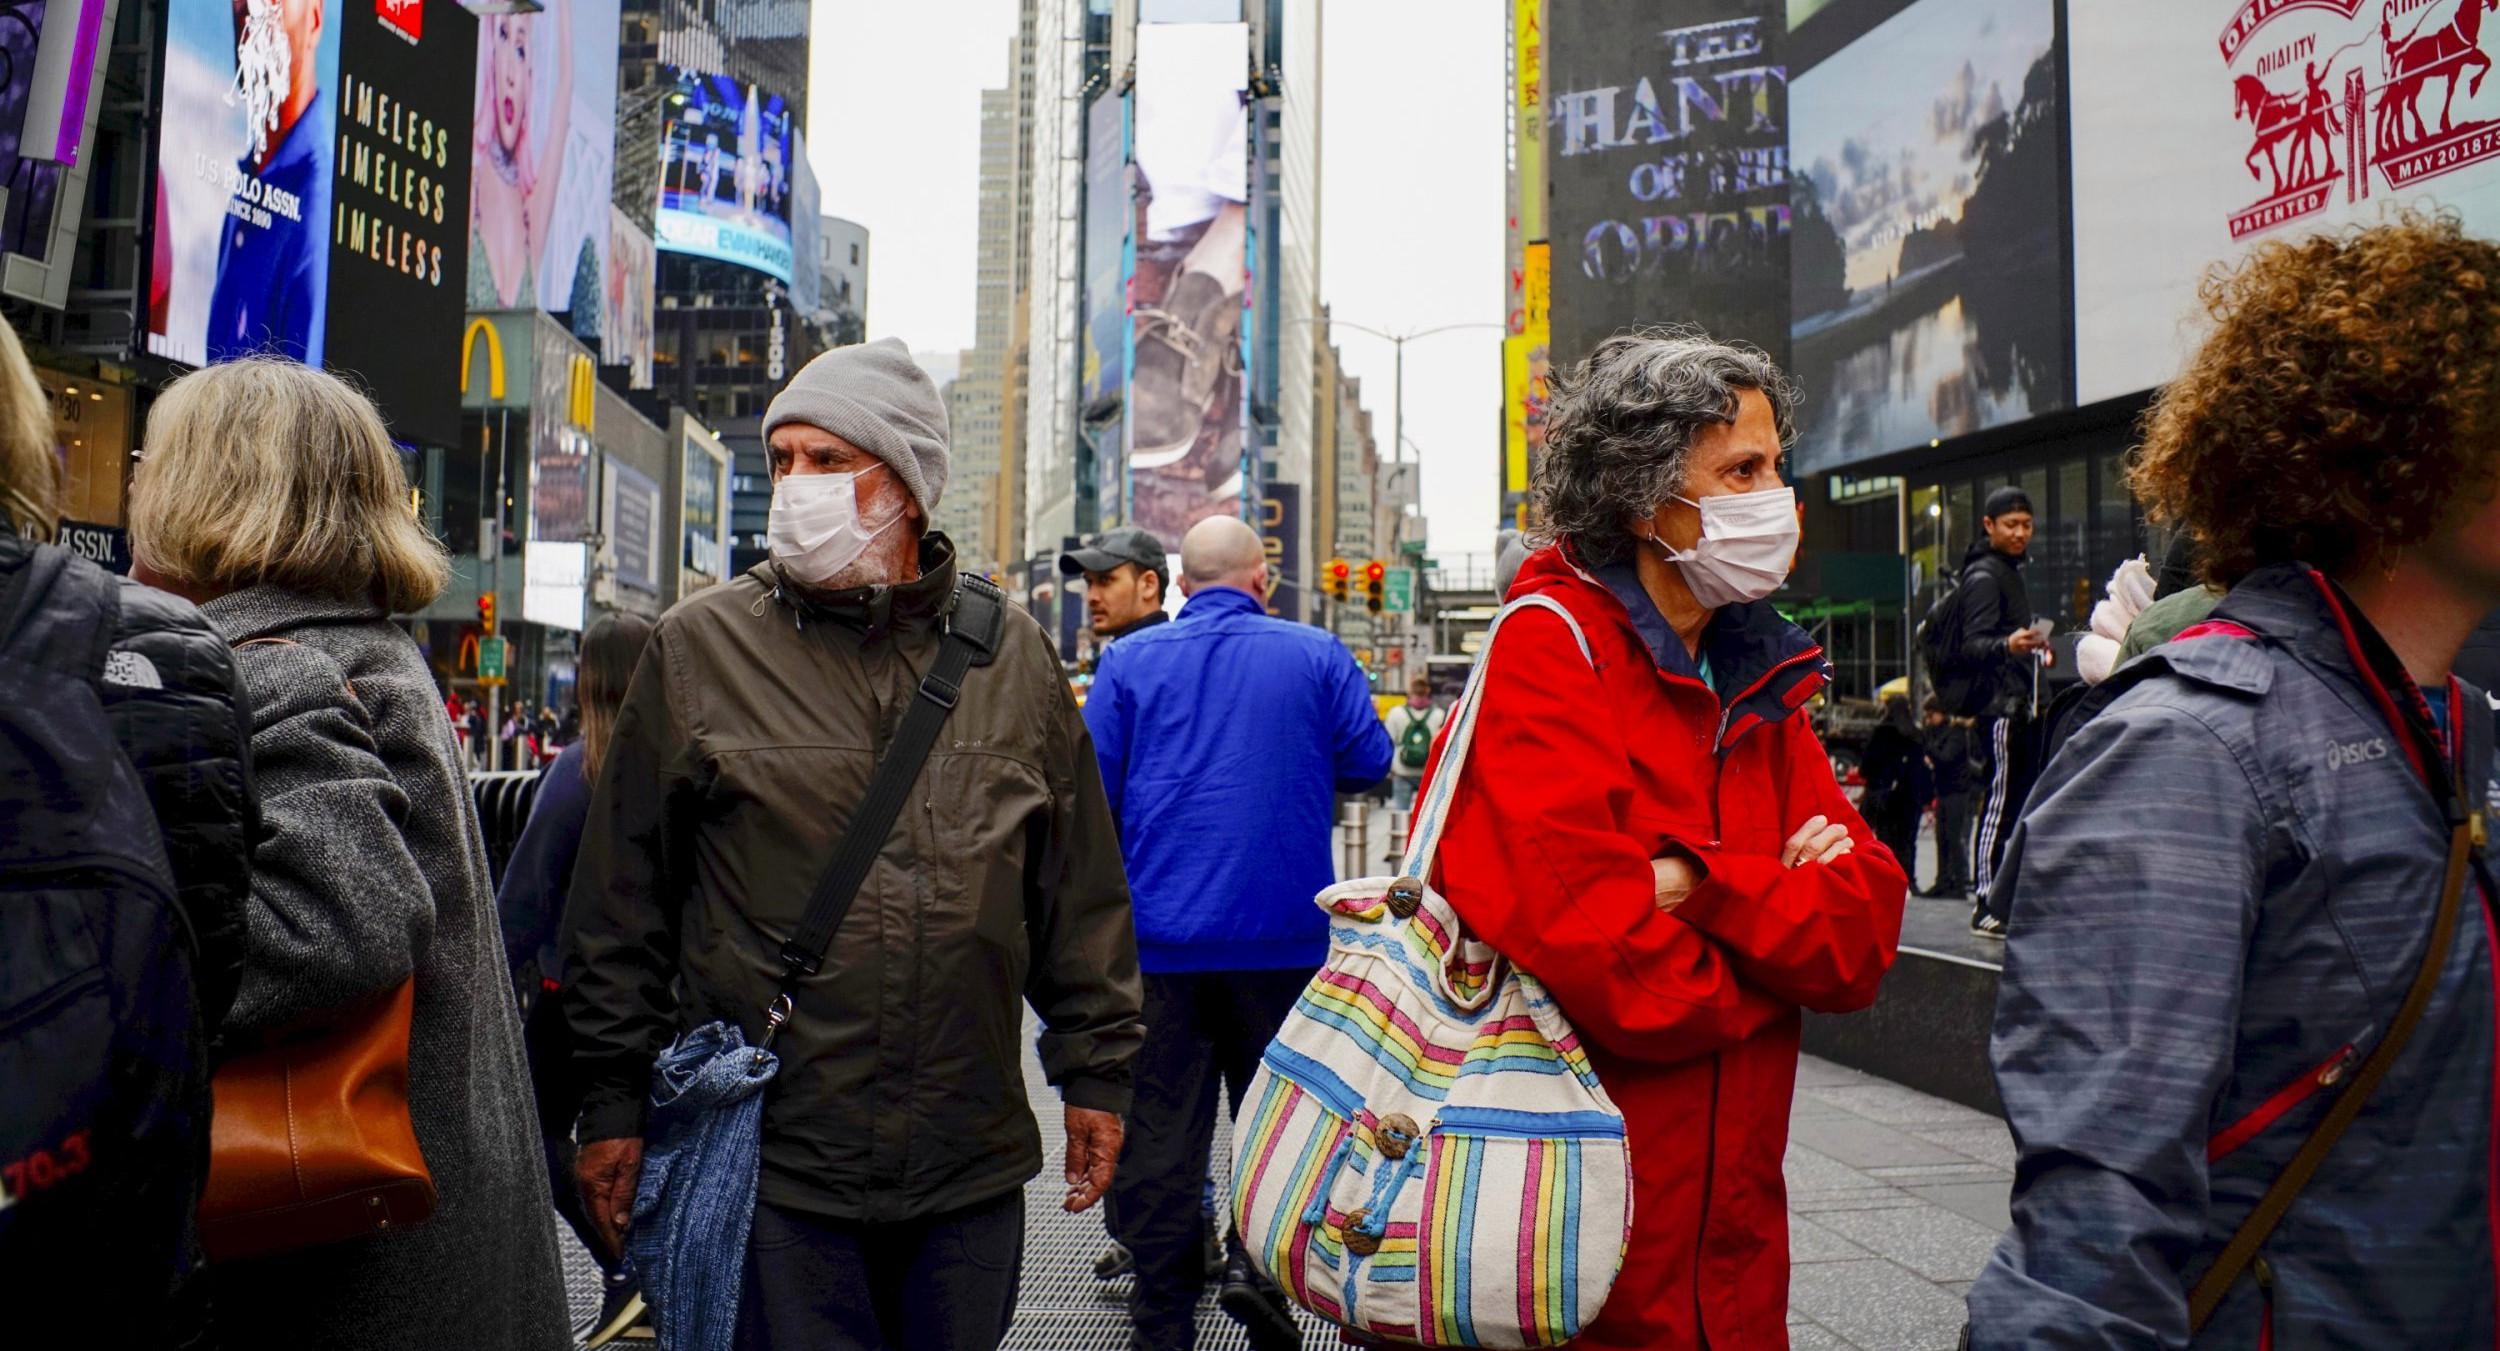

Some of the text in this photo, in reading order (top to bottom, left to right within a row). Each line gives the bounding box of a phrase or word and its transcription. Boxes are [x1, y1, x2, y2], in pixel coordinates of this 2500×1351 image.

[2399, 155, 2433, 179] MAY
[2437, 150, 2458, 166] 20
[195, 152, 302, 222] U.S. POLO ASSN.
[2233, 194, 2319, 235] PATENTED
[60, 527, 116, 563] ASSN.
